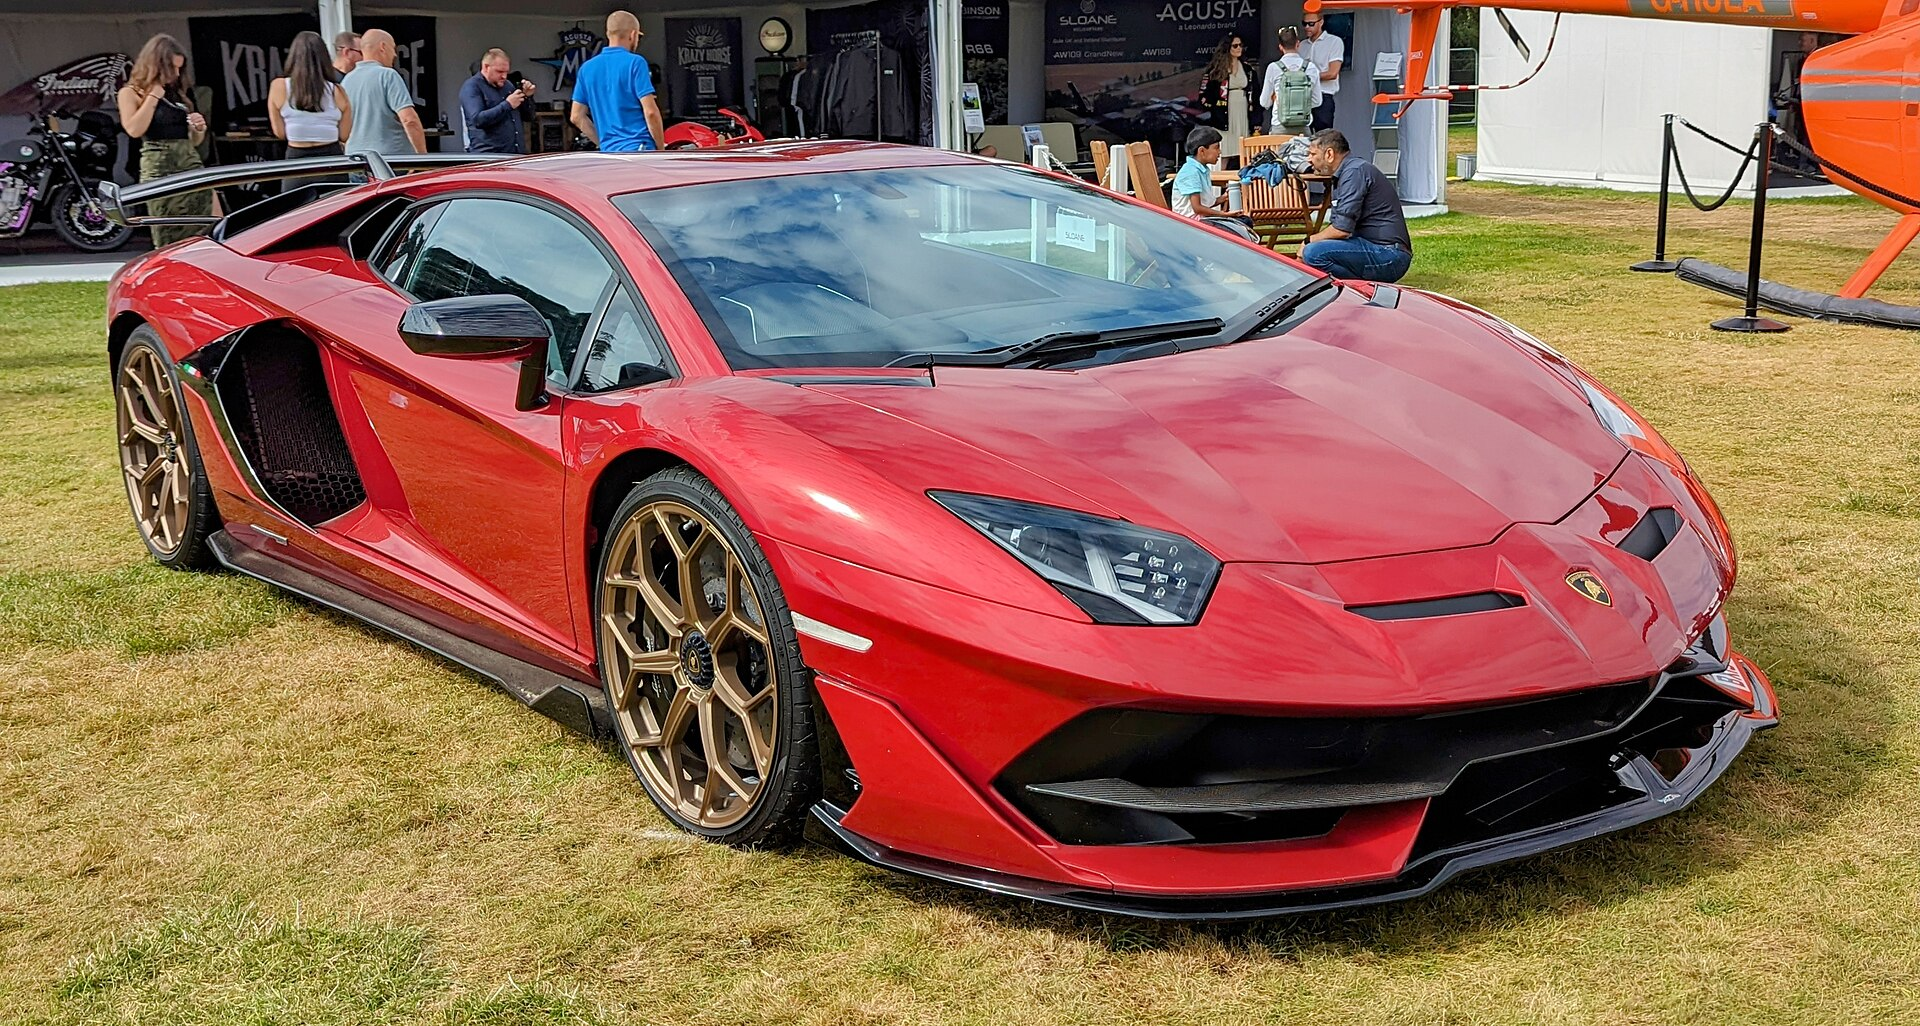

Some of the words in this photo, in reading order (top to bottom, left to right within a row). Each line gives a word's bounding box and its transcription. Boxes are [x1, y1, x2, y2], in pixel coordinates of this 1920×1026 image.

[962, 6, 1001, 15] BINSON
[1156, 0, 1256, 21] AGUSTA
[1059, 14, 1117, 26] SLOANE
[1184, 22, 1216, 31] Leonardo
[1217, 21, 1237, 29] brand
[563, 33, 592, 42] AGUSTA
[965, 44, 994, 54] R66
[1195, 46, 1217, 54] AW10
[678, 46, 705, 65] KRAZY
[706, 46, 731, 65] HORSE
[1053, 50, 1081, 59] AW109
[220, 39, 291, 111] KRA
[36, 72, 99, 91] Indian
